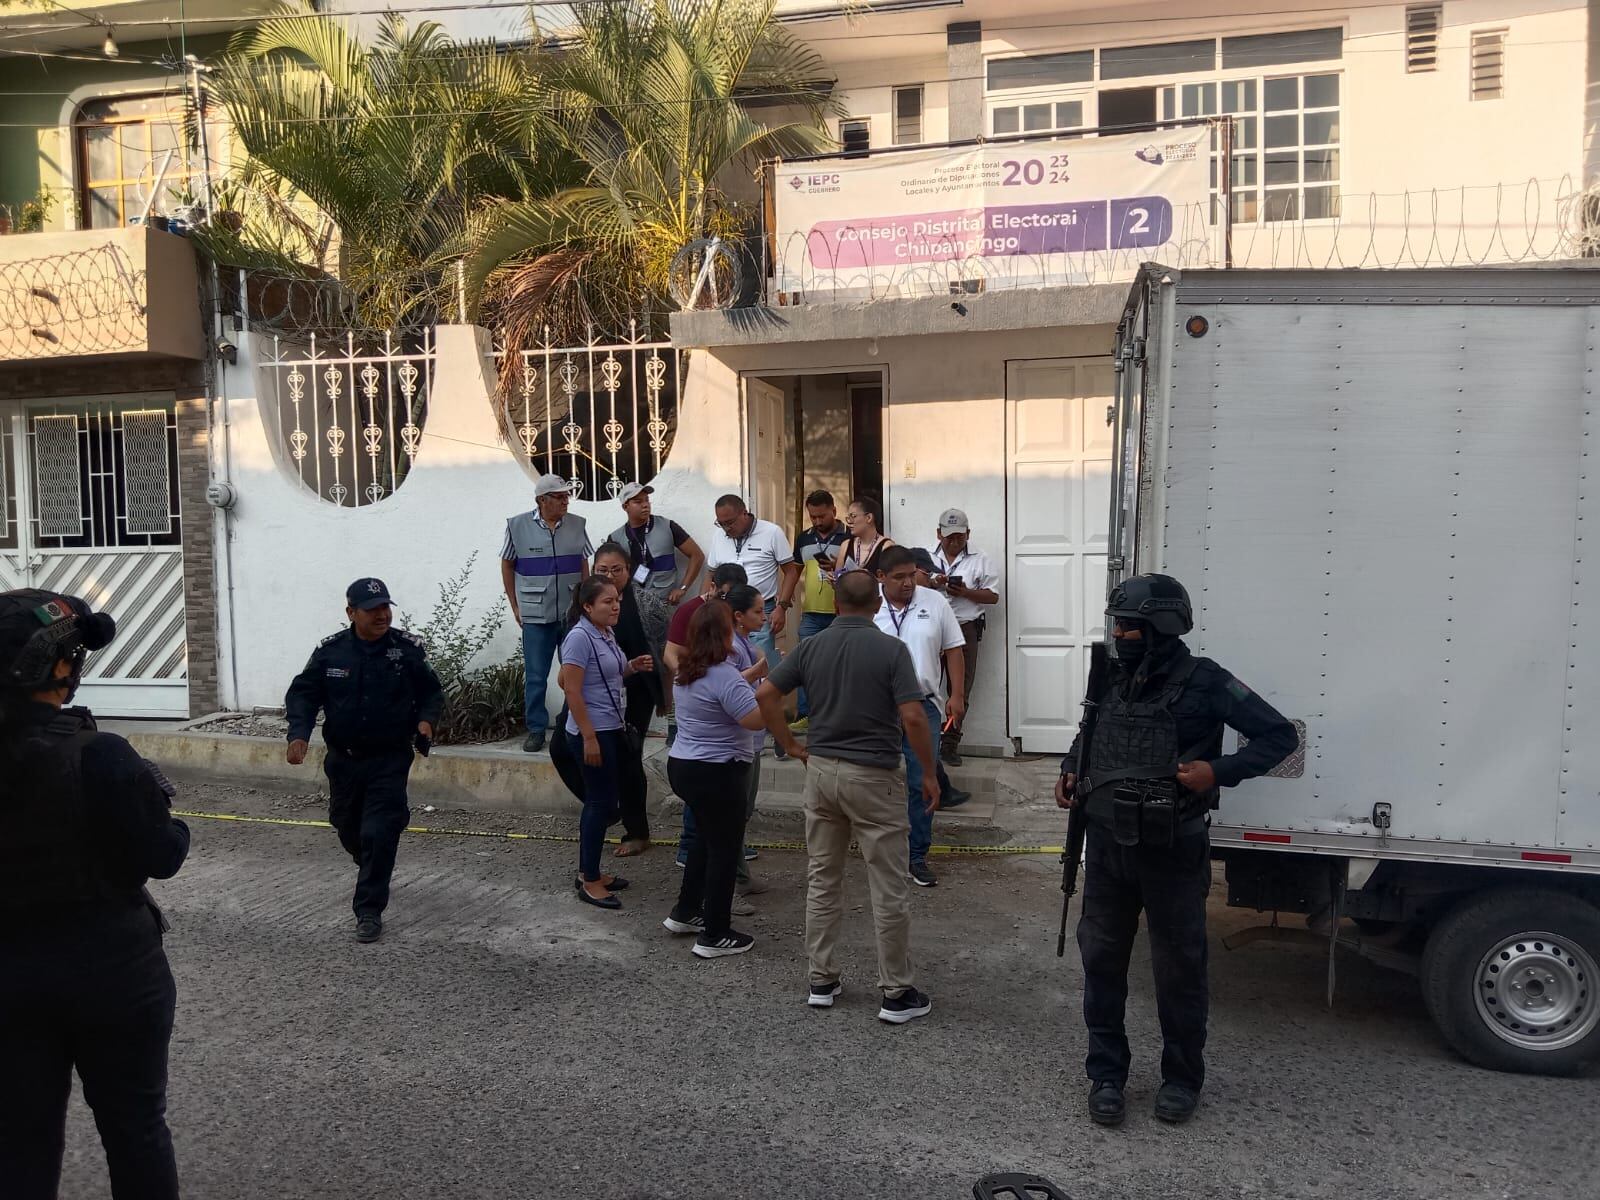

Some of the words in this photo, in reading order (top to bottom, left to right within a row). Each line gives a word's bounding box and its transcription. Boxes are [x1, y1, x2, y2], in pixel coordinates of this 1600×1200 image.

[1049, 155, 1069, 168] 23
[934, 165, 965, 175] Proceso
[1002, 159, 1045, 186] 20
[1049, 171, 1070, 184] 24
[808, 174, 840, 186] IEPC
[900, 177, 937, 187] Ordinario
[949, 171, 1000, 182] Diputacones
[808, 186, 841, 194] GUERRERO
[905, 186, 934, 196] Locales
[942, 181, 1000, 192] Ayuntamntos
[835, 222, 908, 242] Consejo
[913, 215, 985, 236] Distrital
[992, 209, 1077, 229] Electoral
[1129, 207, 1150, 234] 2
[895, 233, 1019, 259] Chilpancingo
